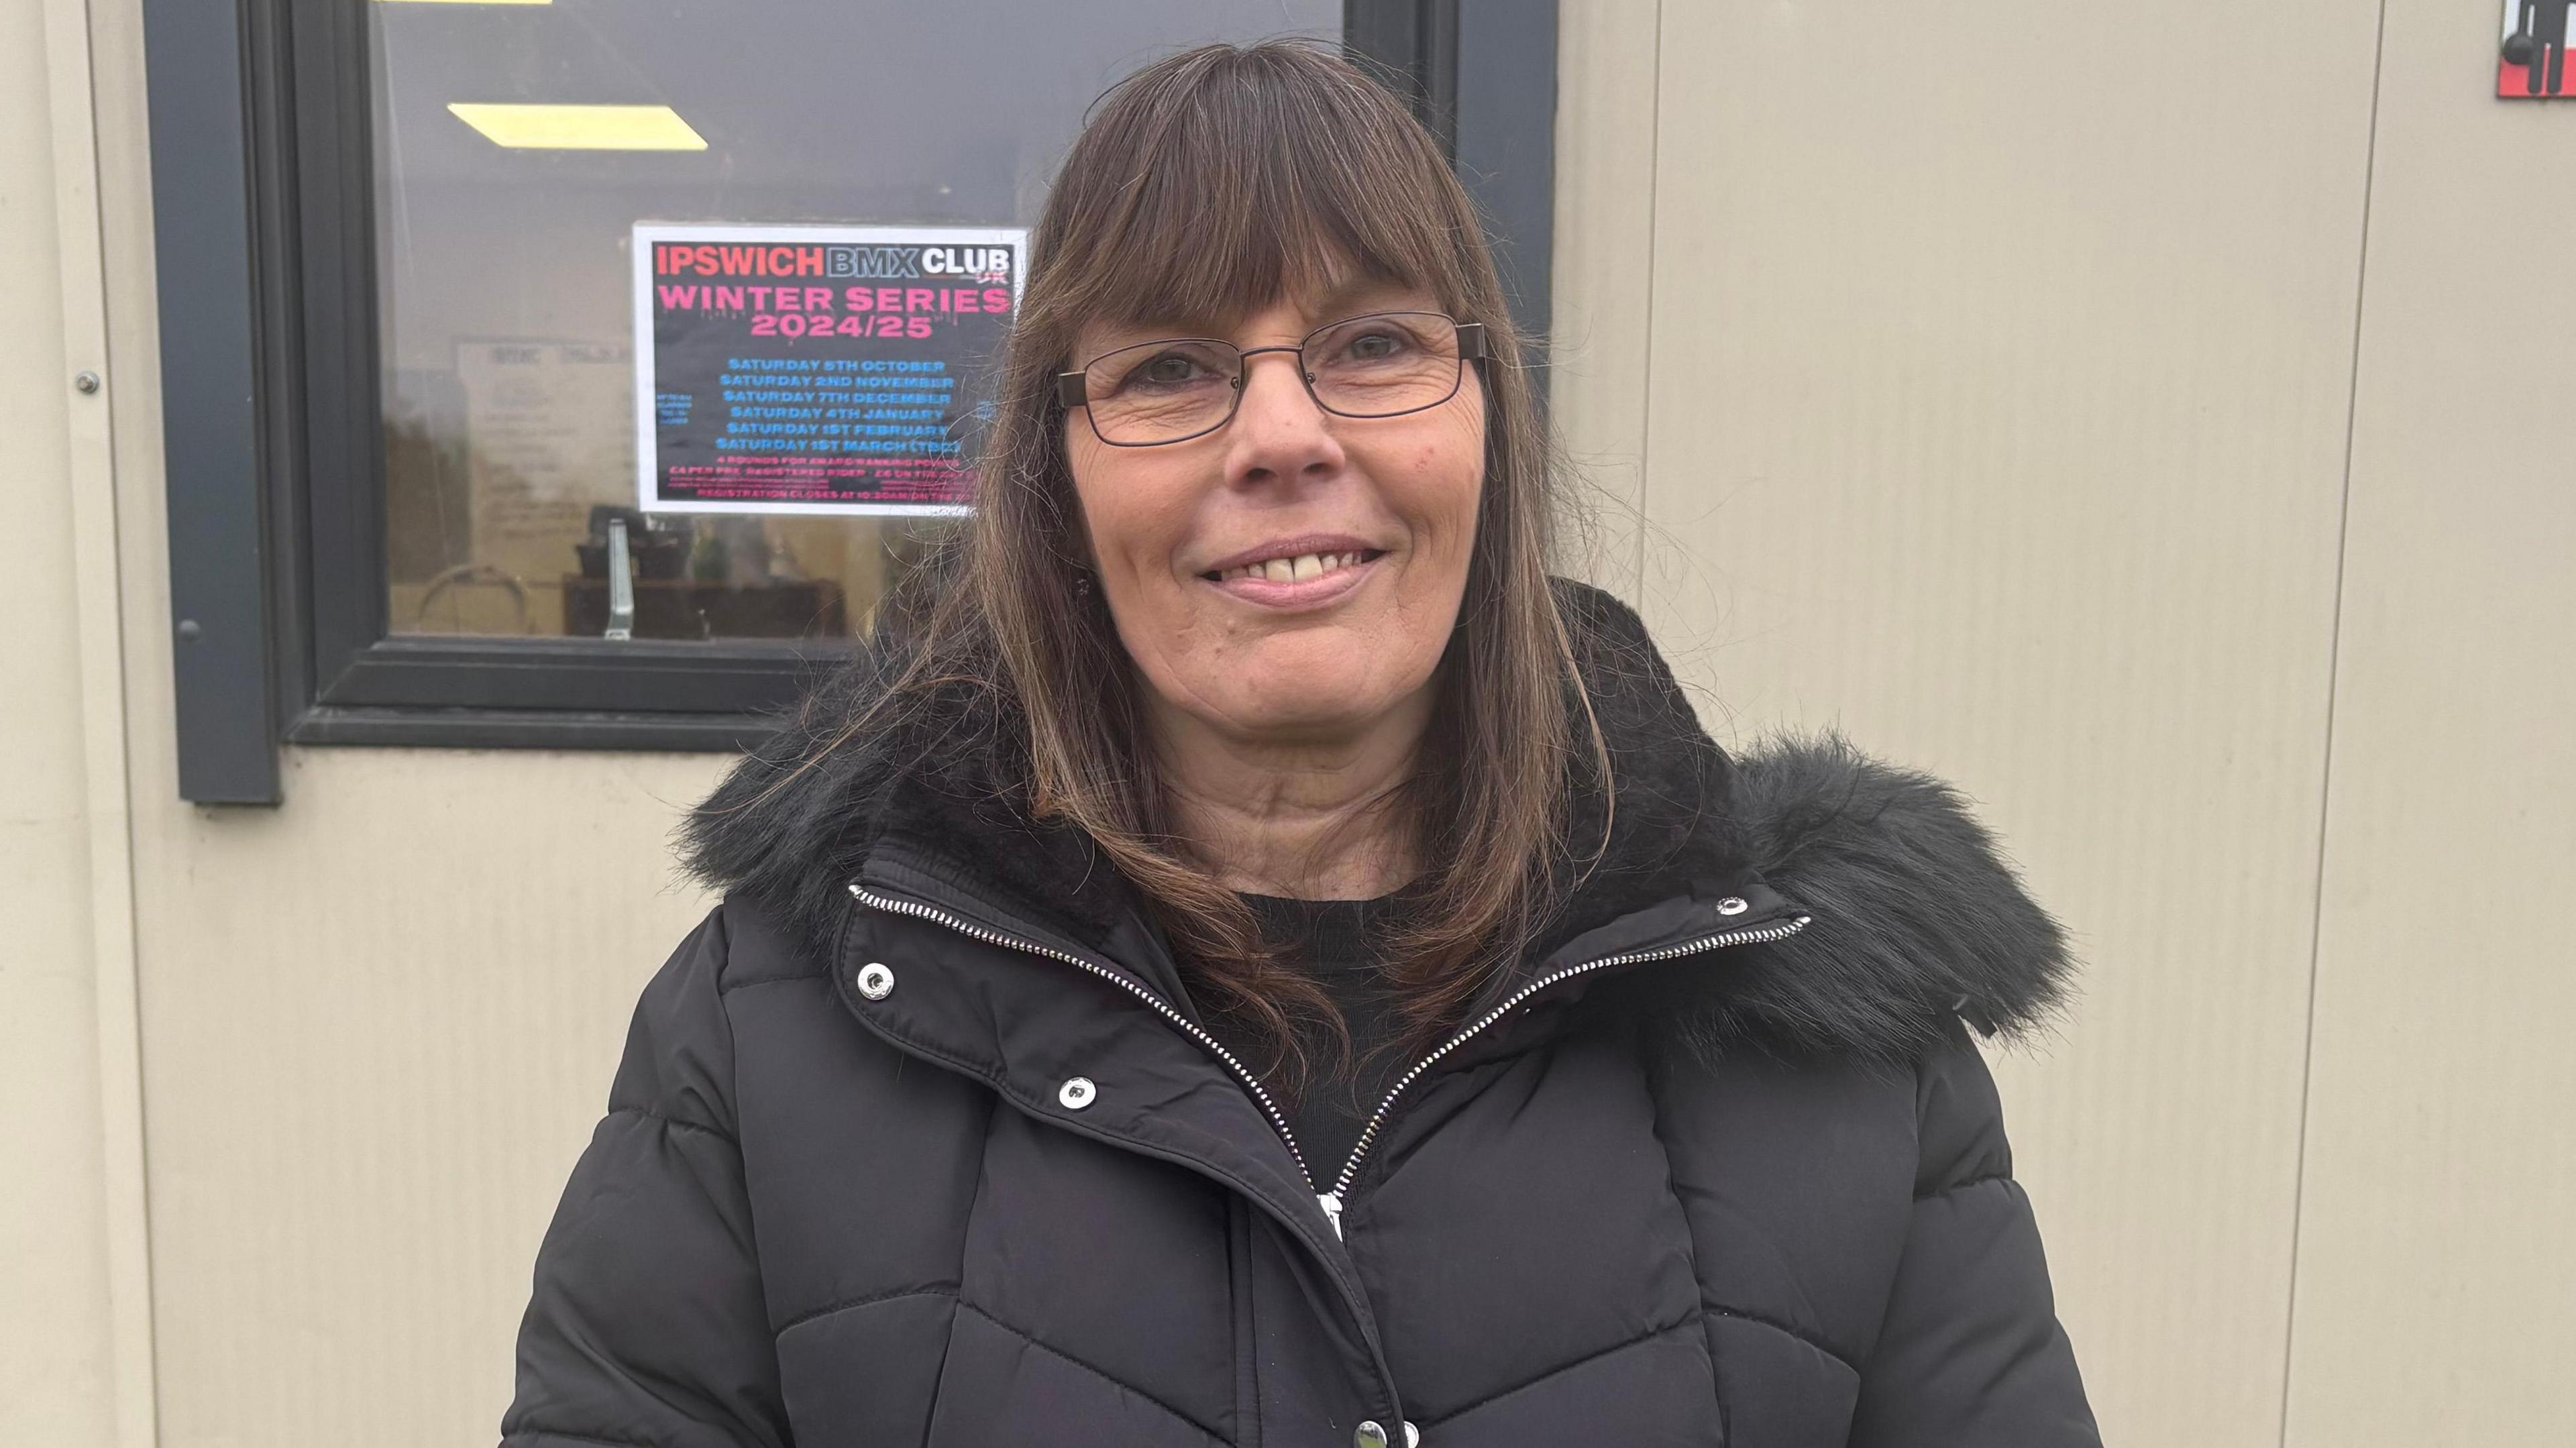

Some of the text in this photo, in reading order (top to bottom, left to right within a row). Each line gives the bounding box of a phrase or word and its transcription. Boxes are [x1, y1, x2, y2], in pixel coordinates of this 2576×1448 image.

[657, 245, 1010, 278] IPSWICH BMX CLUB
[974, 270, 1010, 284] UK
[657, 285, 1010, 314] WINTER SERIES
[751, 313, 933, 339] 2024/25
[728, 359, 820, 371] SATURDAY
[861, 360, 945, 372] OCTOBER
[720, 374, 955, 388] SATURDAY 2ND NOVEMBER
[722, 390, 952, 404] SATURDAY 7TH DECEMBER
[730, 406, 945, 420] SATURDAY 4TH JANUARY
[727, 422, 949, 436] SATURDAY 1ST FEBRUARY
[715, 438, 808, 451] SATURDAY
[811, 440, 840, 451] 1ST
[843, 440, 906, 451] MARCH
